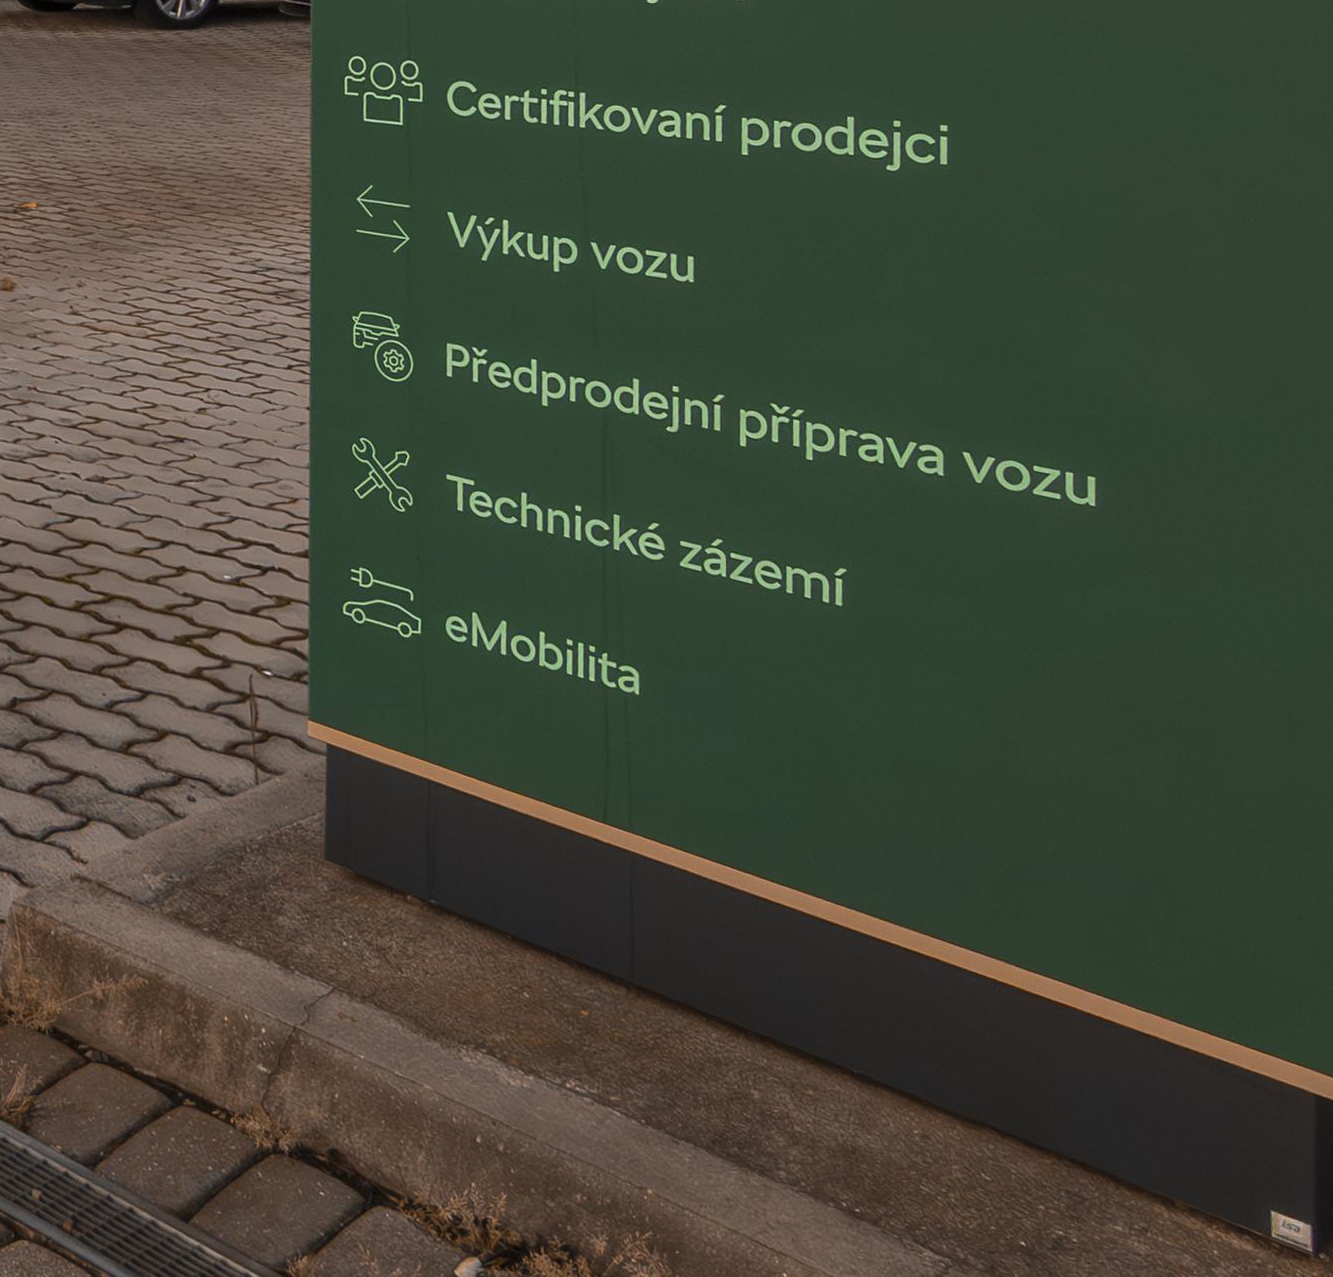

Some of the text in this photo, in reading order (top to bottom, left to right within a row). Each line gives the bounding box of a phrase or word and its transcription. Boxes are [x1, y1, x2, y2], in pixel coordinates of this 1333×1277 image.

[446, 80, 948, 172] Certifikovaní prodejci
[446, 211, 695, 283] Výkup vozu
[446, 342, 1096, 507] Předprodejní příprava vozu
[445, 474, 847, 607] Technické zázemí
[445, 611, 640, 696] eMobilita
